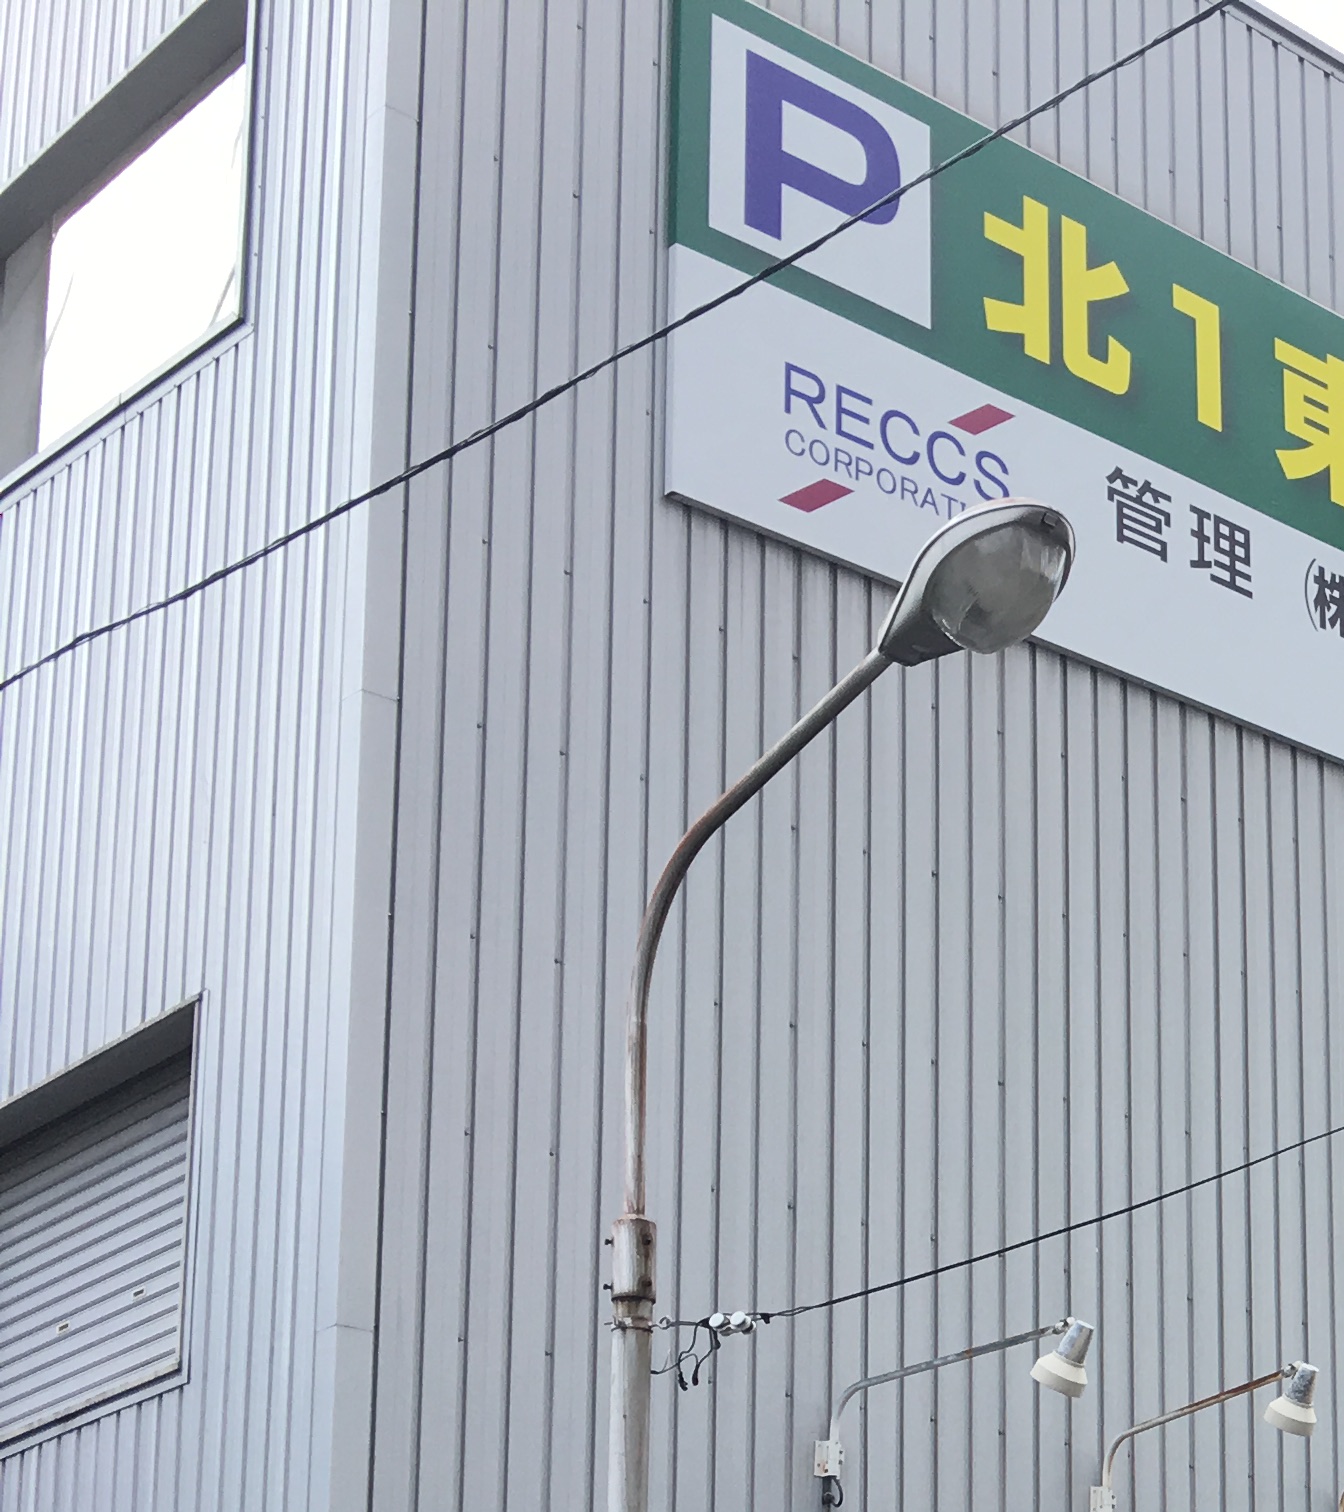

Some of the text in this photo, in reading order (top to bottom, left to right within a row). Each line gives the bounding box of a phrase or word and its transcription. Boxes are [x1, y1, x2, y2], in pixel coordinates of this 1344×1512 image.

[744, 49, 900, 241] P
[784, 361, 1010, 501] RECCS
[784, 429, 967, 521] CORPORAT
[1105, 466, 1254, 599] 管理
